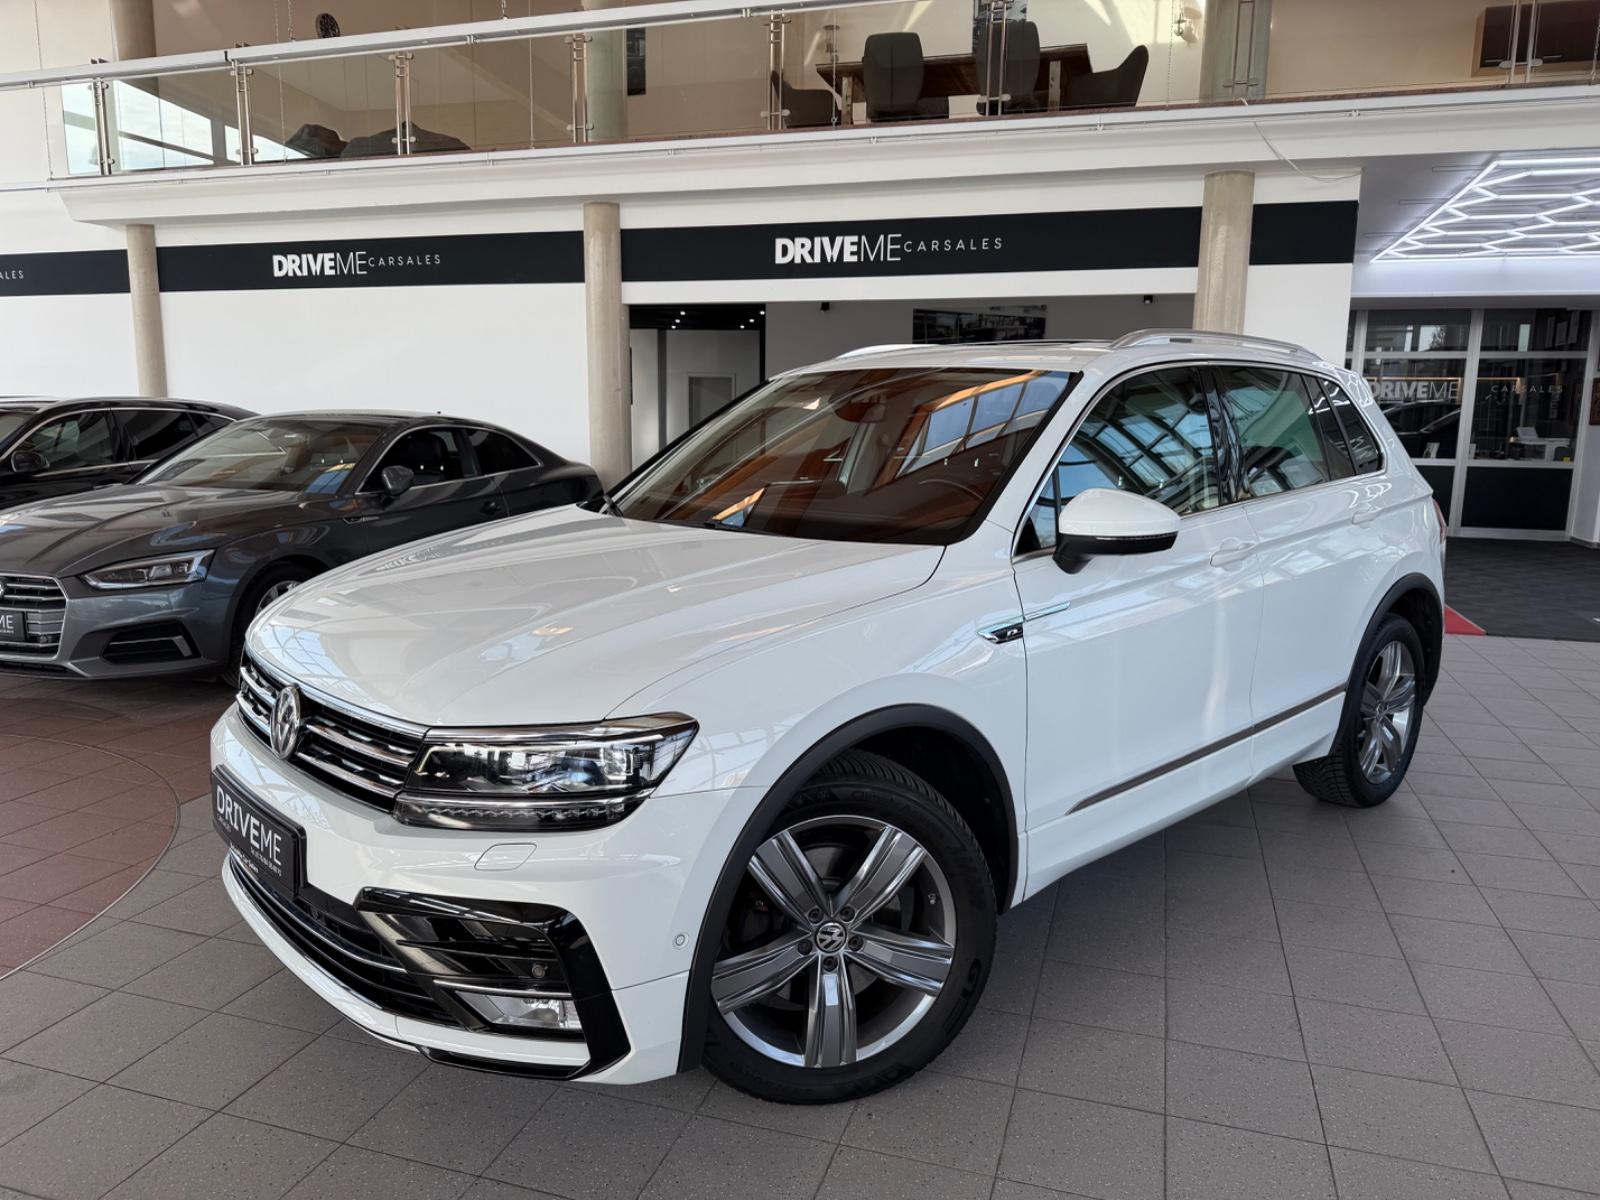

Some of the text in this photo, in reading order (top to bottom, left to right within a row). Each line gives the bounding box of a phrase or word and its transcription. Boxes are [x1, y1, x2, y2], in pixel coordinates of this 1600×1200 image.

[272, 251, 441, 277] DRIVEME CARSALES
[775, 234, 1002, 264] DRIVEME CARSALES
[216, 785, 282, 866] DRIVEME
